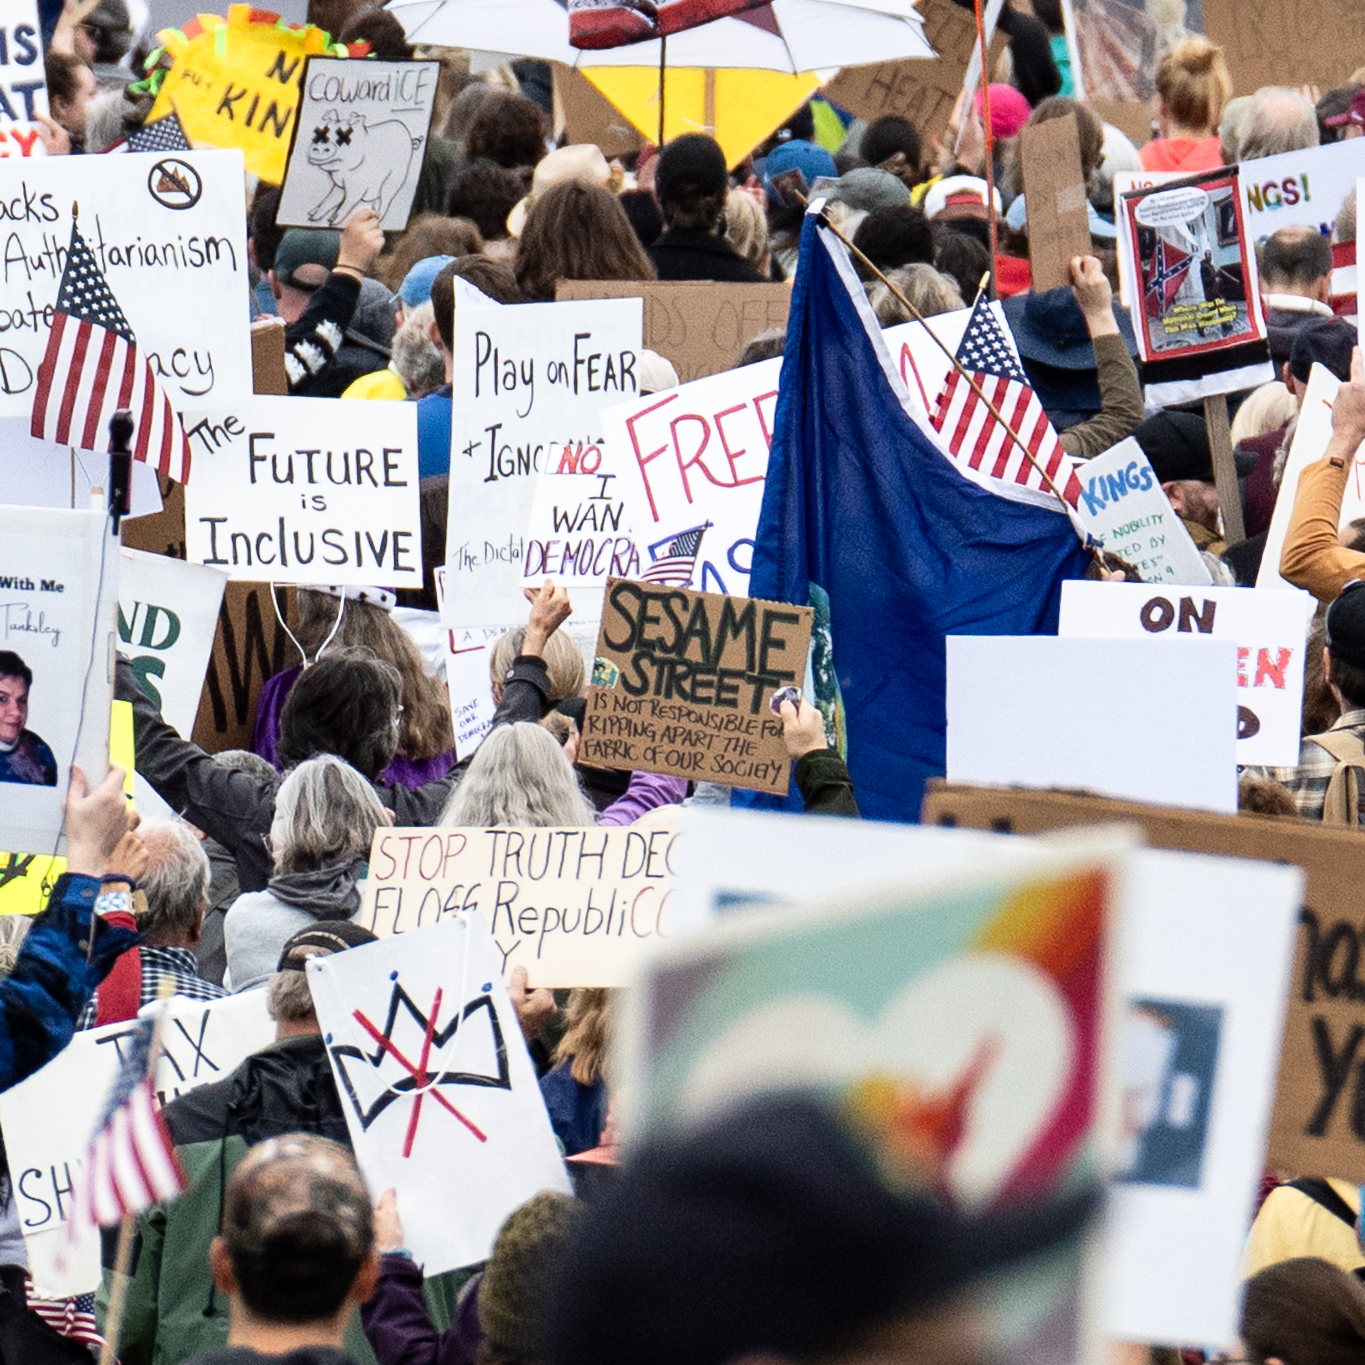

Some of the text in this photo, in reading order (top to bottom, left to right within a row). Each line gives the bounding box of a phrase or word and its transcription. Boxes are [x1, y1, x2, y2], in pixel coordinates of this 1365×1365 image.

[474, 331, 637, 419] Play on FEAR
[188, 414, 246, 455] The
[557, 444, 602, 475] NO
[300, 493, 328, 513] is
[1079, 460, 1154, 517] KINGS
[552, 502, 624, 533] WAN
[1113, 513, 1165, 540] NOBILITY
[454, 544, 479, 572] The
[1149, 534, 1167, 550] BY
[40, 579, 65, 595] Me
[602, 581, 801, 682] SESAME
[1139, 595, 1217, 635] ON
[620, 648, 782, 716] STREET
[593, 692, 759, 734] IS NOT RESPONSIBLE
[583, 738, 640, 761] FABRIC
[643, 744, 666, 765] OF
[665, 749, 706, 772] OUR
[587, 715, 758, 757] RIPPING APART THE
[373, 830, 610, 883] STOP TRUTH
